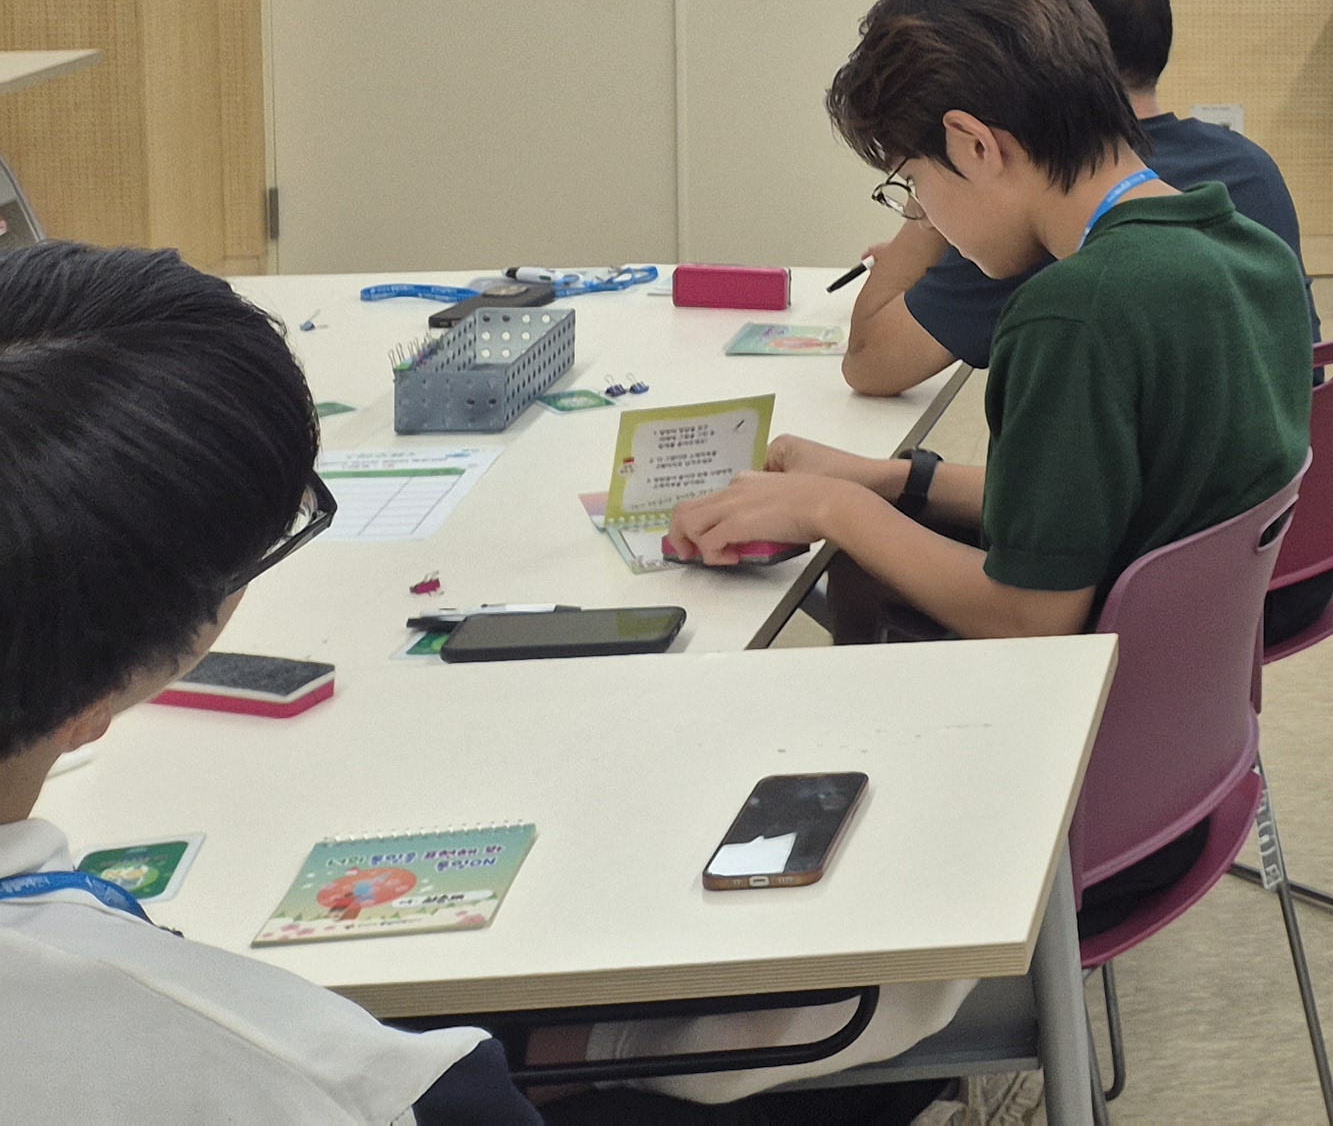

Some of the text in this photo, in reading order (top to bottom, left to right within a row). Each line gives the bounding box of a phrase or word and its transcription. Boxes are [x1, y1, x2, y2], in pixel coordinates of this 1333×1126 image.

[371, 852, 416, 866] 통일을
[424, 848, 478, 862] 표현해
[436, 857, 497, 872] 통일ON
